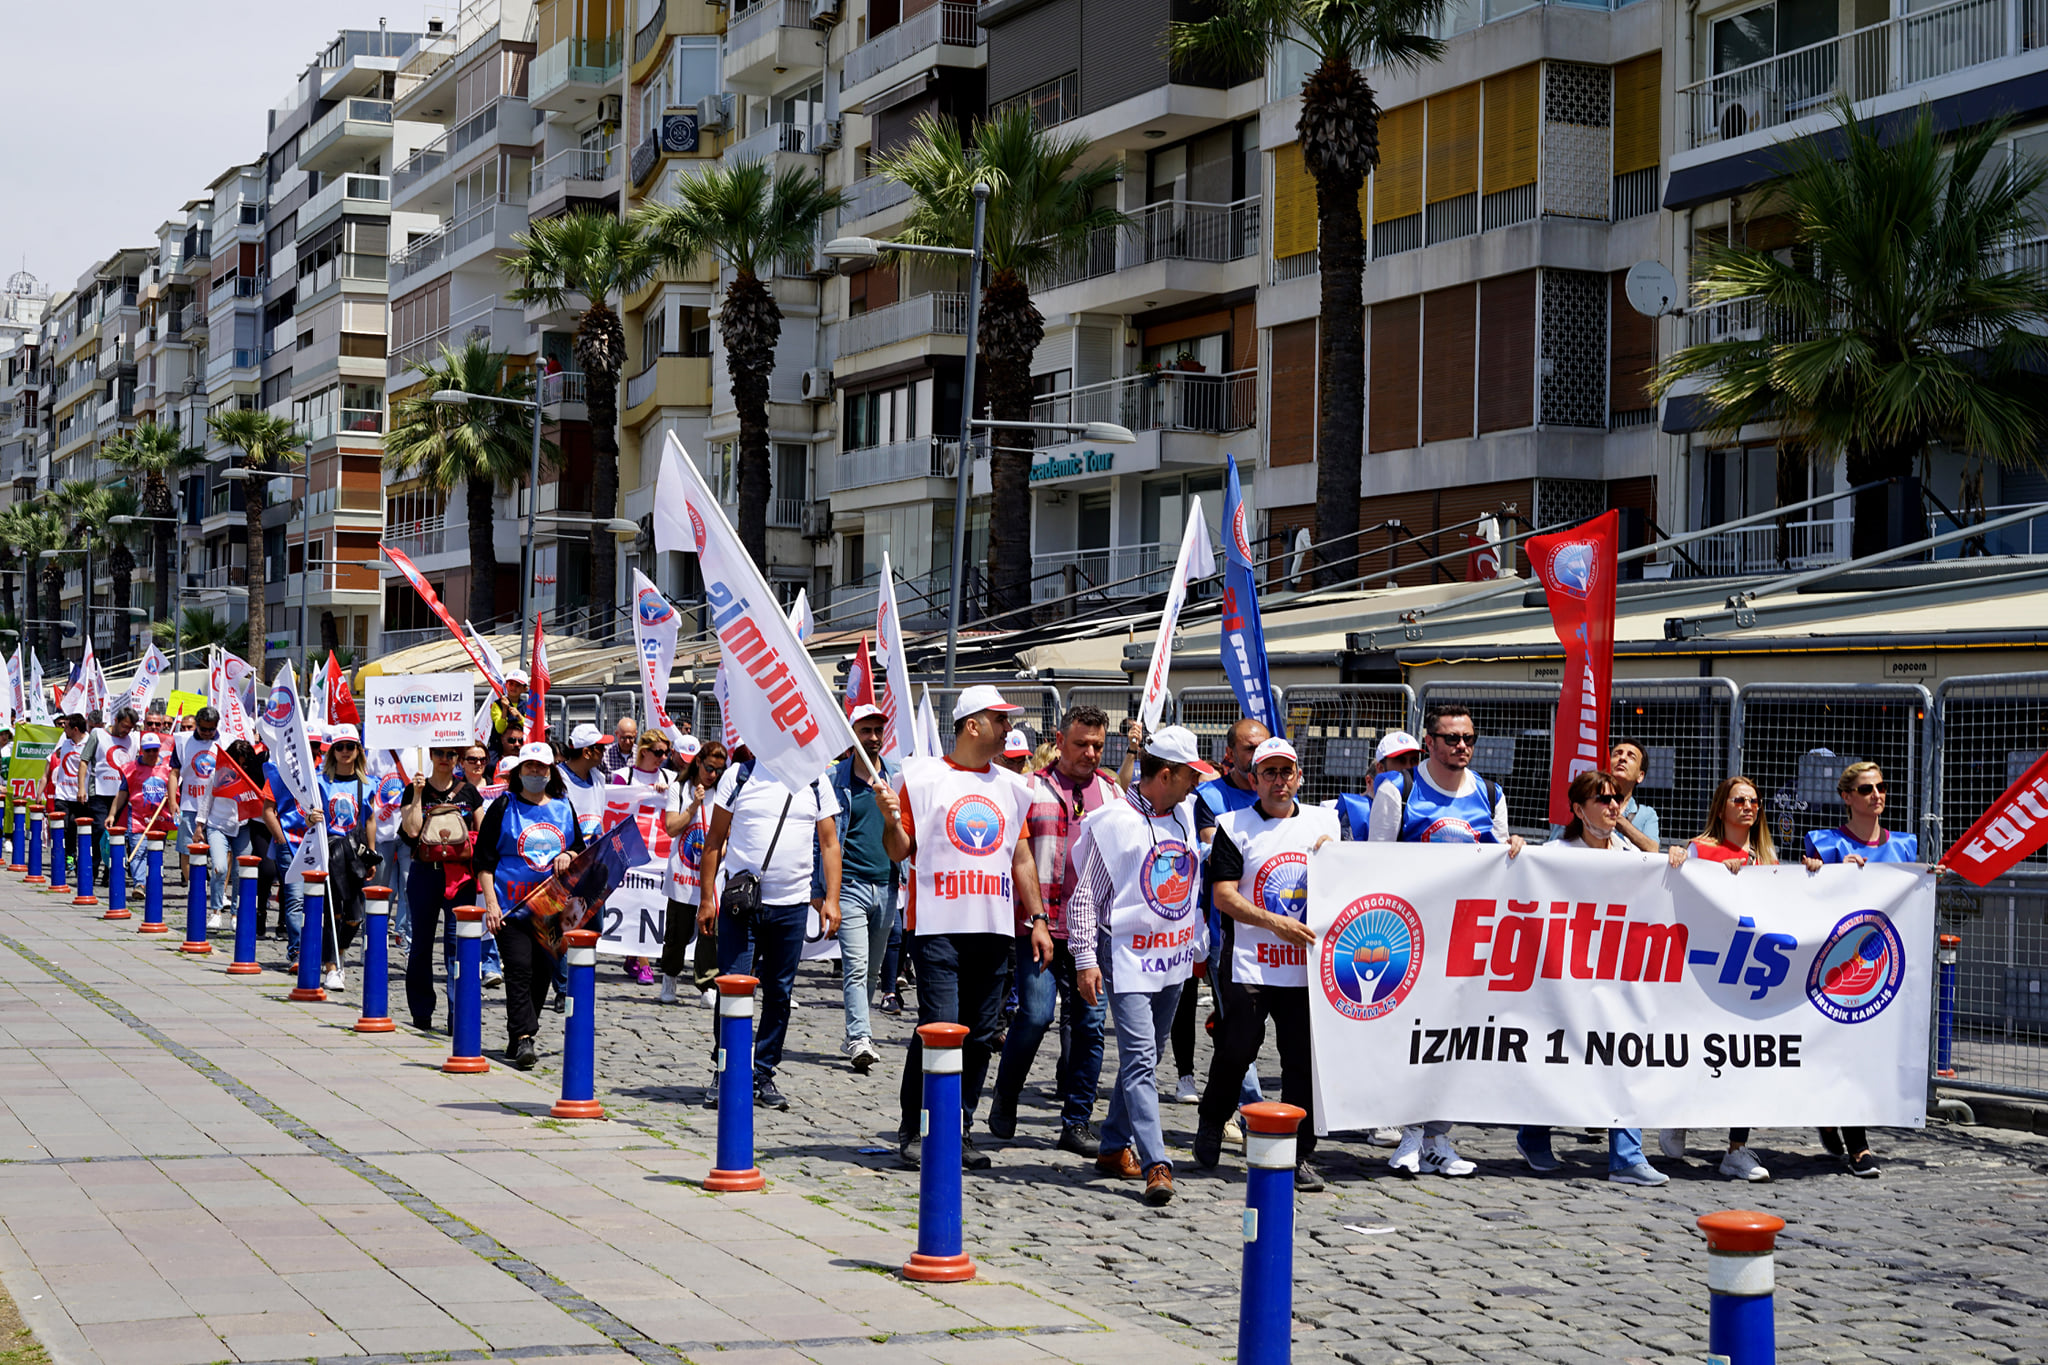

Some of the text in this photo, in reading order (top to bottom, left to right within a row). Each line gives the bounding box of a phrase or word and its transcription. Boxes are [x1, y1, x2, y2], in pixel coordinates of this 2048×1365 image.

[1029, 450, 1114, 481] cademic Tour
[1534, 668, 1559, 678] popcorn
[1892, 662, 1927, 673] popcorn
[374, 692, 463, 707] İŞ GÜVENCEMİZİ
[376, 712, 462, 726] TARTIŞMAYIZ
[934, 870, 1012, 902] Eğitimiş
[1132, 921, 1195, 950] BİRLEŞİ
[1323, 896, 1421, 993] EĞİTİM VE BİLİM İŞGÖRENLERİ SENDİKASI
[1446, 899, 1798, 1000] Eğitim-iş
[1335, 996, 1398, 1019] EĞİTİM-İŞ
[1810, 987, 1893, 1021] BİRLEŞİK KAMU-İŞ
[1409, 1015, 1802, 1078] İZMİR 1 NOLU ŞUBE
